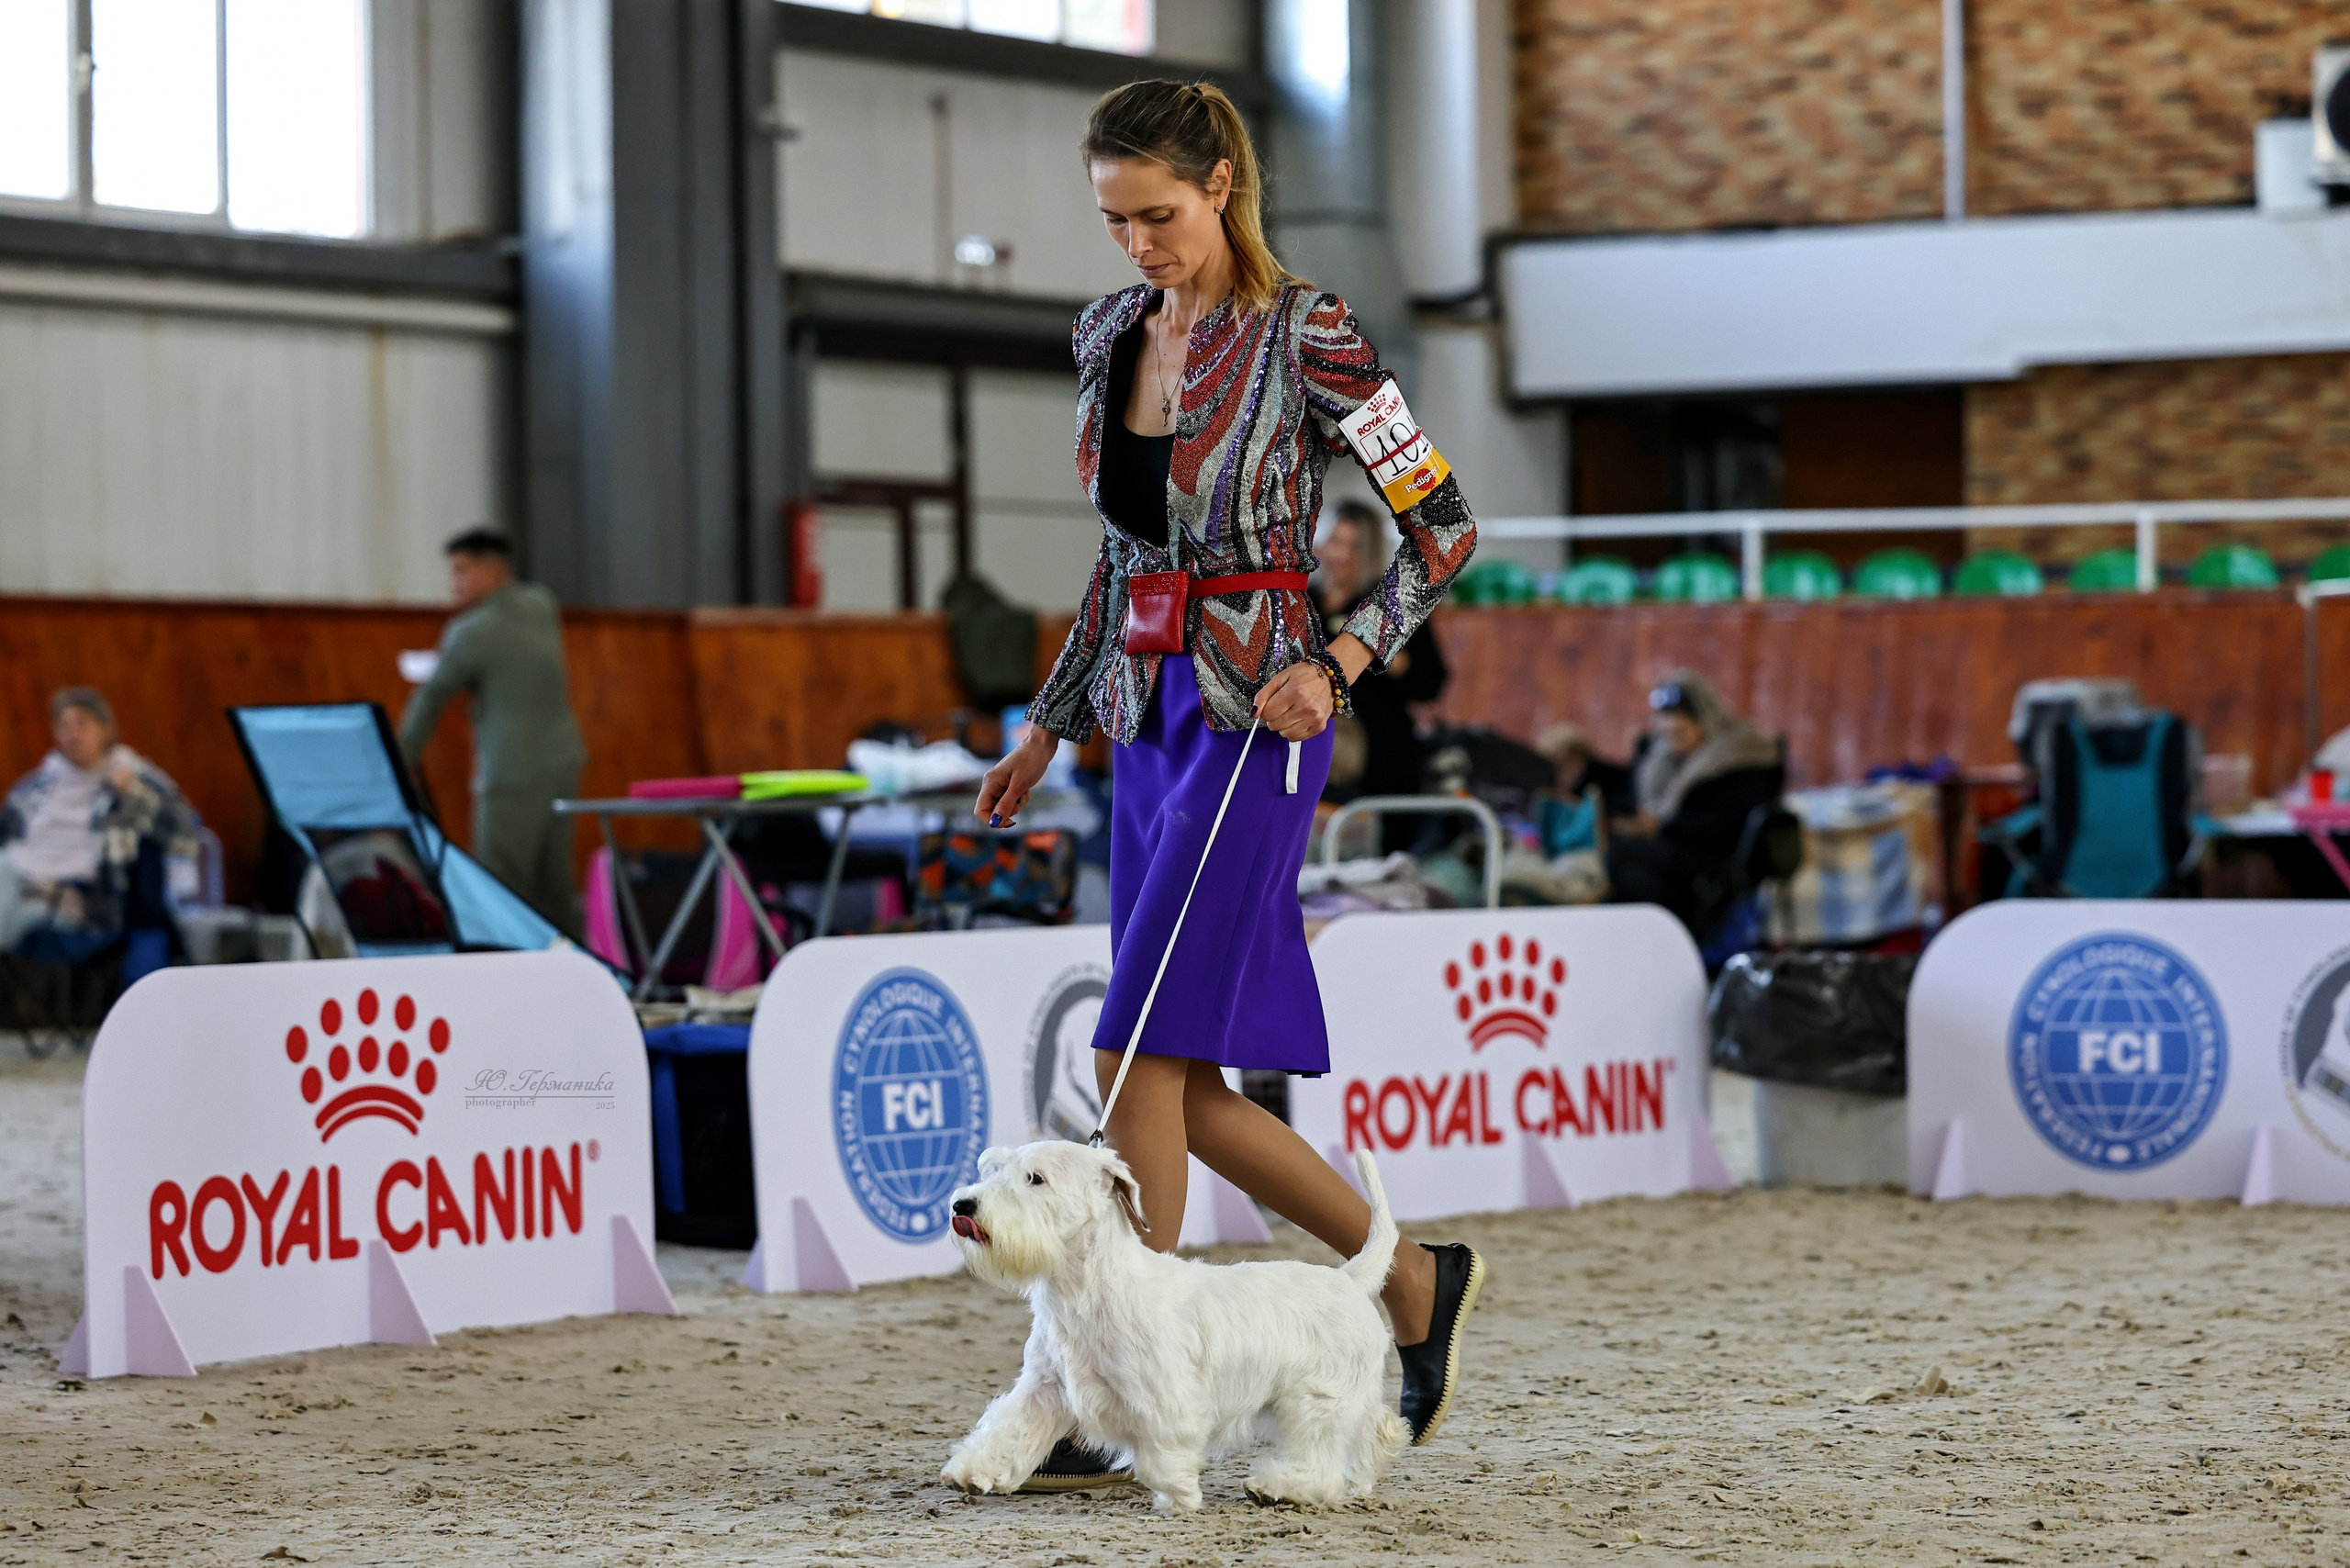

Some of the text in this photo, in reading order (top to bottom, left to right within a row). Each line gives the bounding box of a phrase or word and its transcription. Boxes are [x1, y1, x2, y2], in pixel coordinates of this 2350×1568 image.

[1357, 413, 1386, 437] ROYAL
[1404, 465, 1438, 494] Pedigree
[2078, 1031, 2161, 1074] FCI
[881, 1080, 945, 1132] FCI
[1344, 1070, 1503, 1153] ROYAL
[150, 1164, 360, 1281] ROYAL
